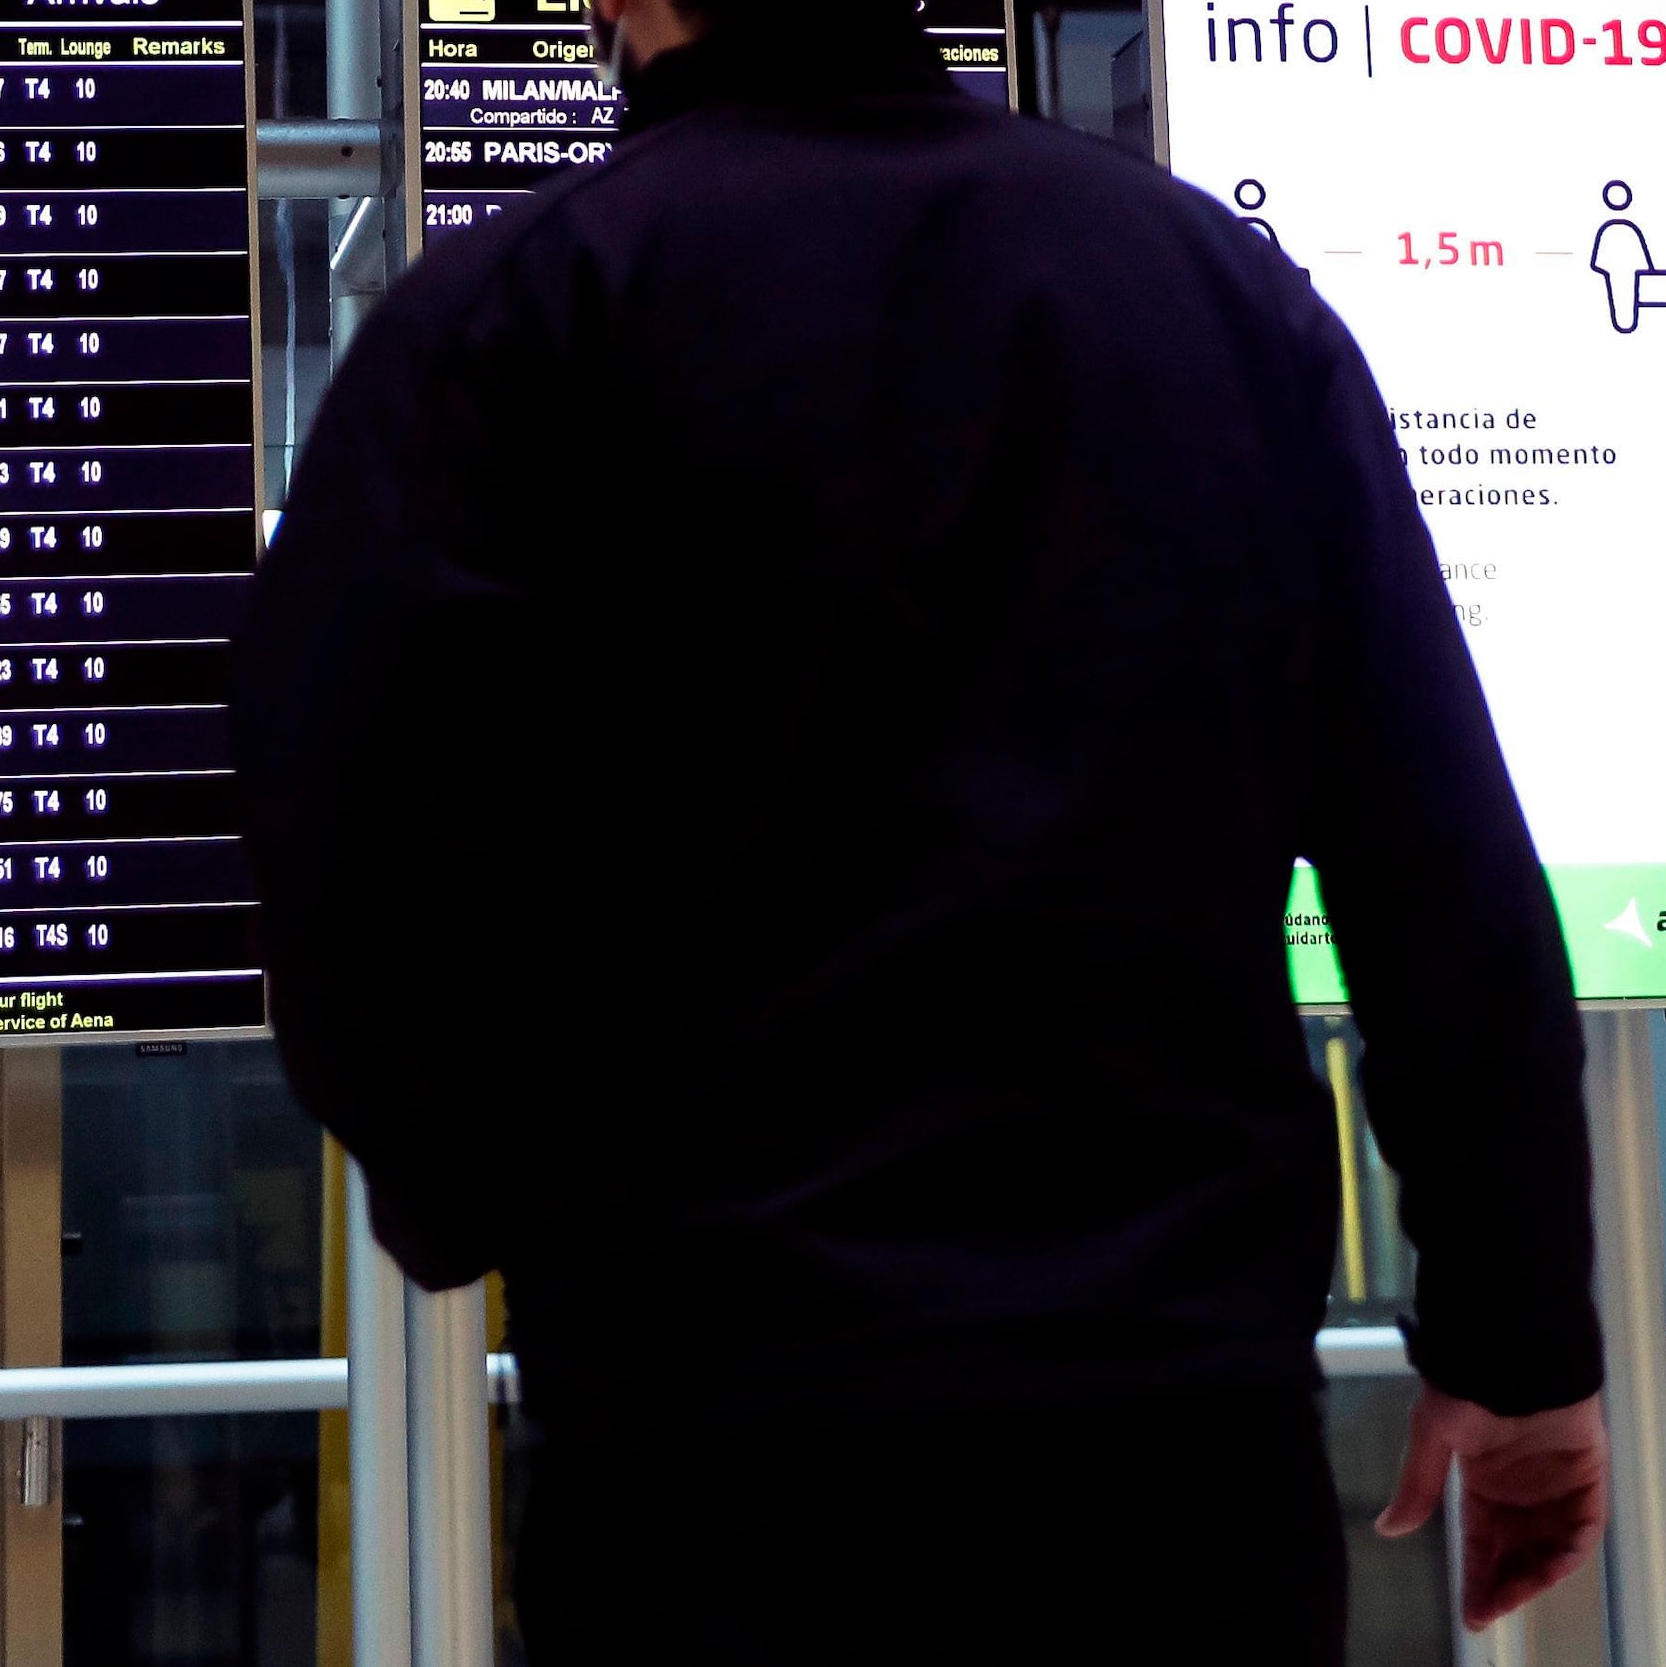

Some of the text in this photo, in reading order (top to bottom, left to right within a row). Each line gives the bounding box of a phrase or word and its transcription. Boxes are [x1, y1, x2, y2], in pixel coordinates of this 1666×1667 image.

[1207, 2, 1337, 62] info
[429, 39, 477, 57] Hora
[940, 44, 999, 61] aciones
[25, 78, 50, 98] T4
[76, 78, 95, 98] 10
[424, 79, 621, 101] 20:40 MILAN/MAL
[470, 107, 614, 127] Compartido AZ
[425, 142, 612, 164] 20:55 PARIS-OR
[427, 204, 472, 225] 21:00
[1390, 408, 1536, 430] istancia de
[1420, 444, 1478, 465] todo
[1491, 446, 1616, 464] momento
[1421, 484, 1557, 505] eraciones.
[1440, 563, 1497, 581] ance
[34, 791, 59, 812] T4
[86, 789, 106, 810] 10
[20, 992, 63, 1009] flight
[50, 1014, 67, 1028] of
[70, 1013, 113, 1028] Aena
